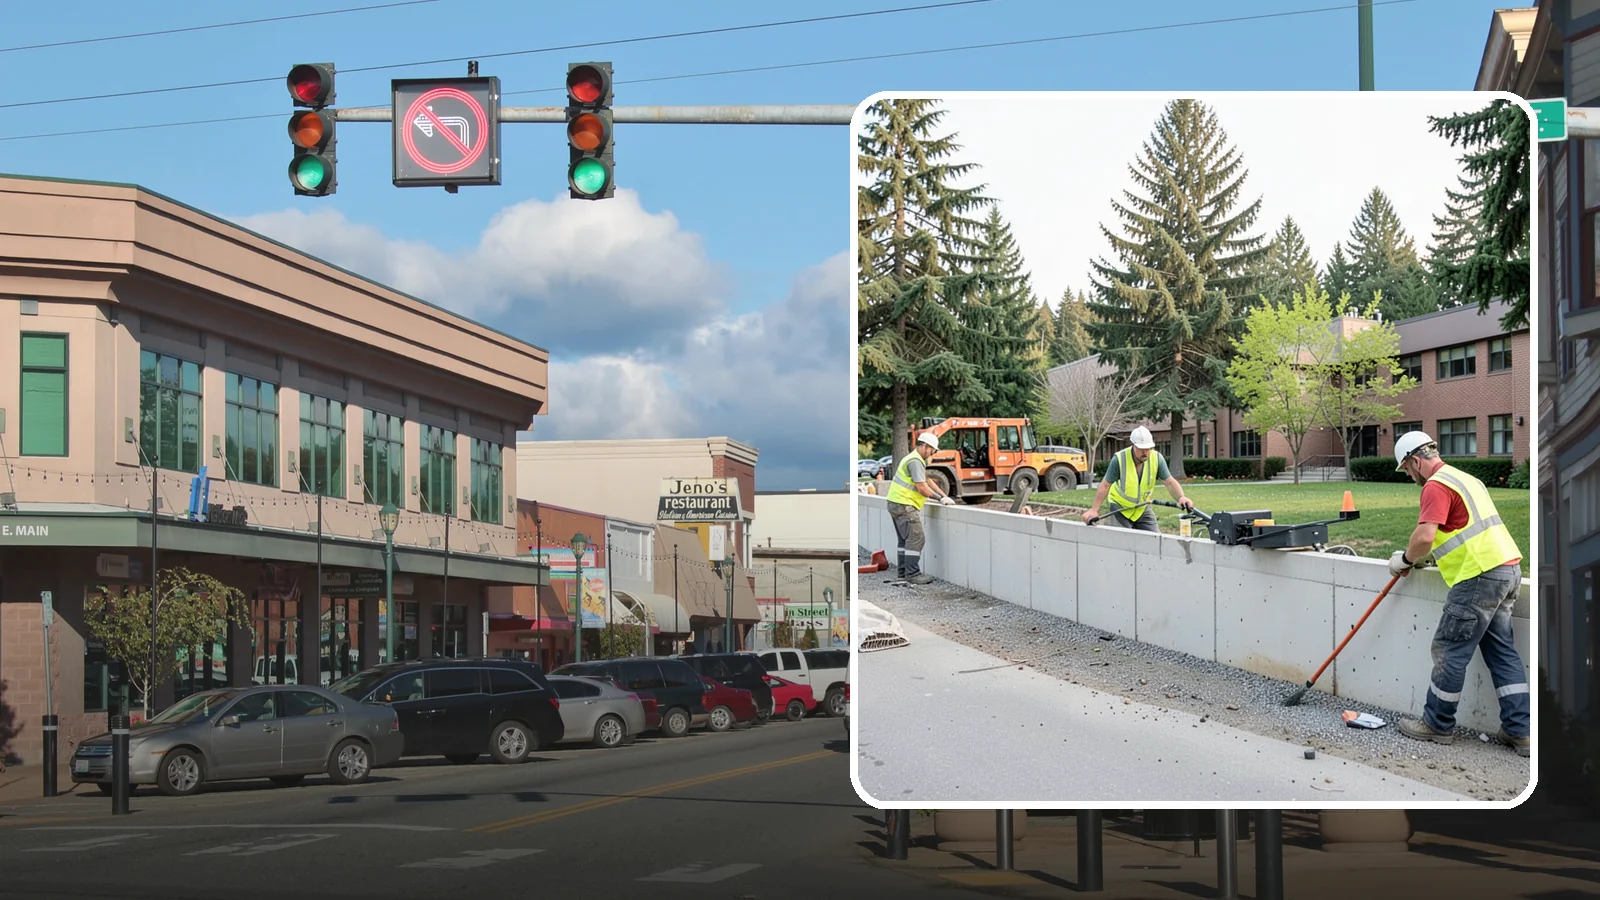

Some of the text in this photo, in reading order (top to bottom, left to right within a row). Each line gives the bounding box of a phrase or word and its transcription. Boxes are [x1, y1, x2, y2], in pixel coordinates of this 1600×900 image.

[669, 480, 727, 494] Jeno's
[665, 496, 731, 509] restaurant
[658, 509, 681, 519] Italian
[685, 509, 715, 519] American
[715, 509, 737, 519] Cuisine
[2, 525, 49, 536] E. MAIN
[797, 607, 829, 617] Street
[790, 619, 823, 627] lass
